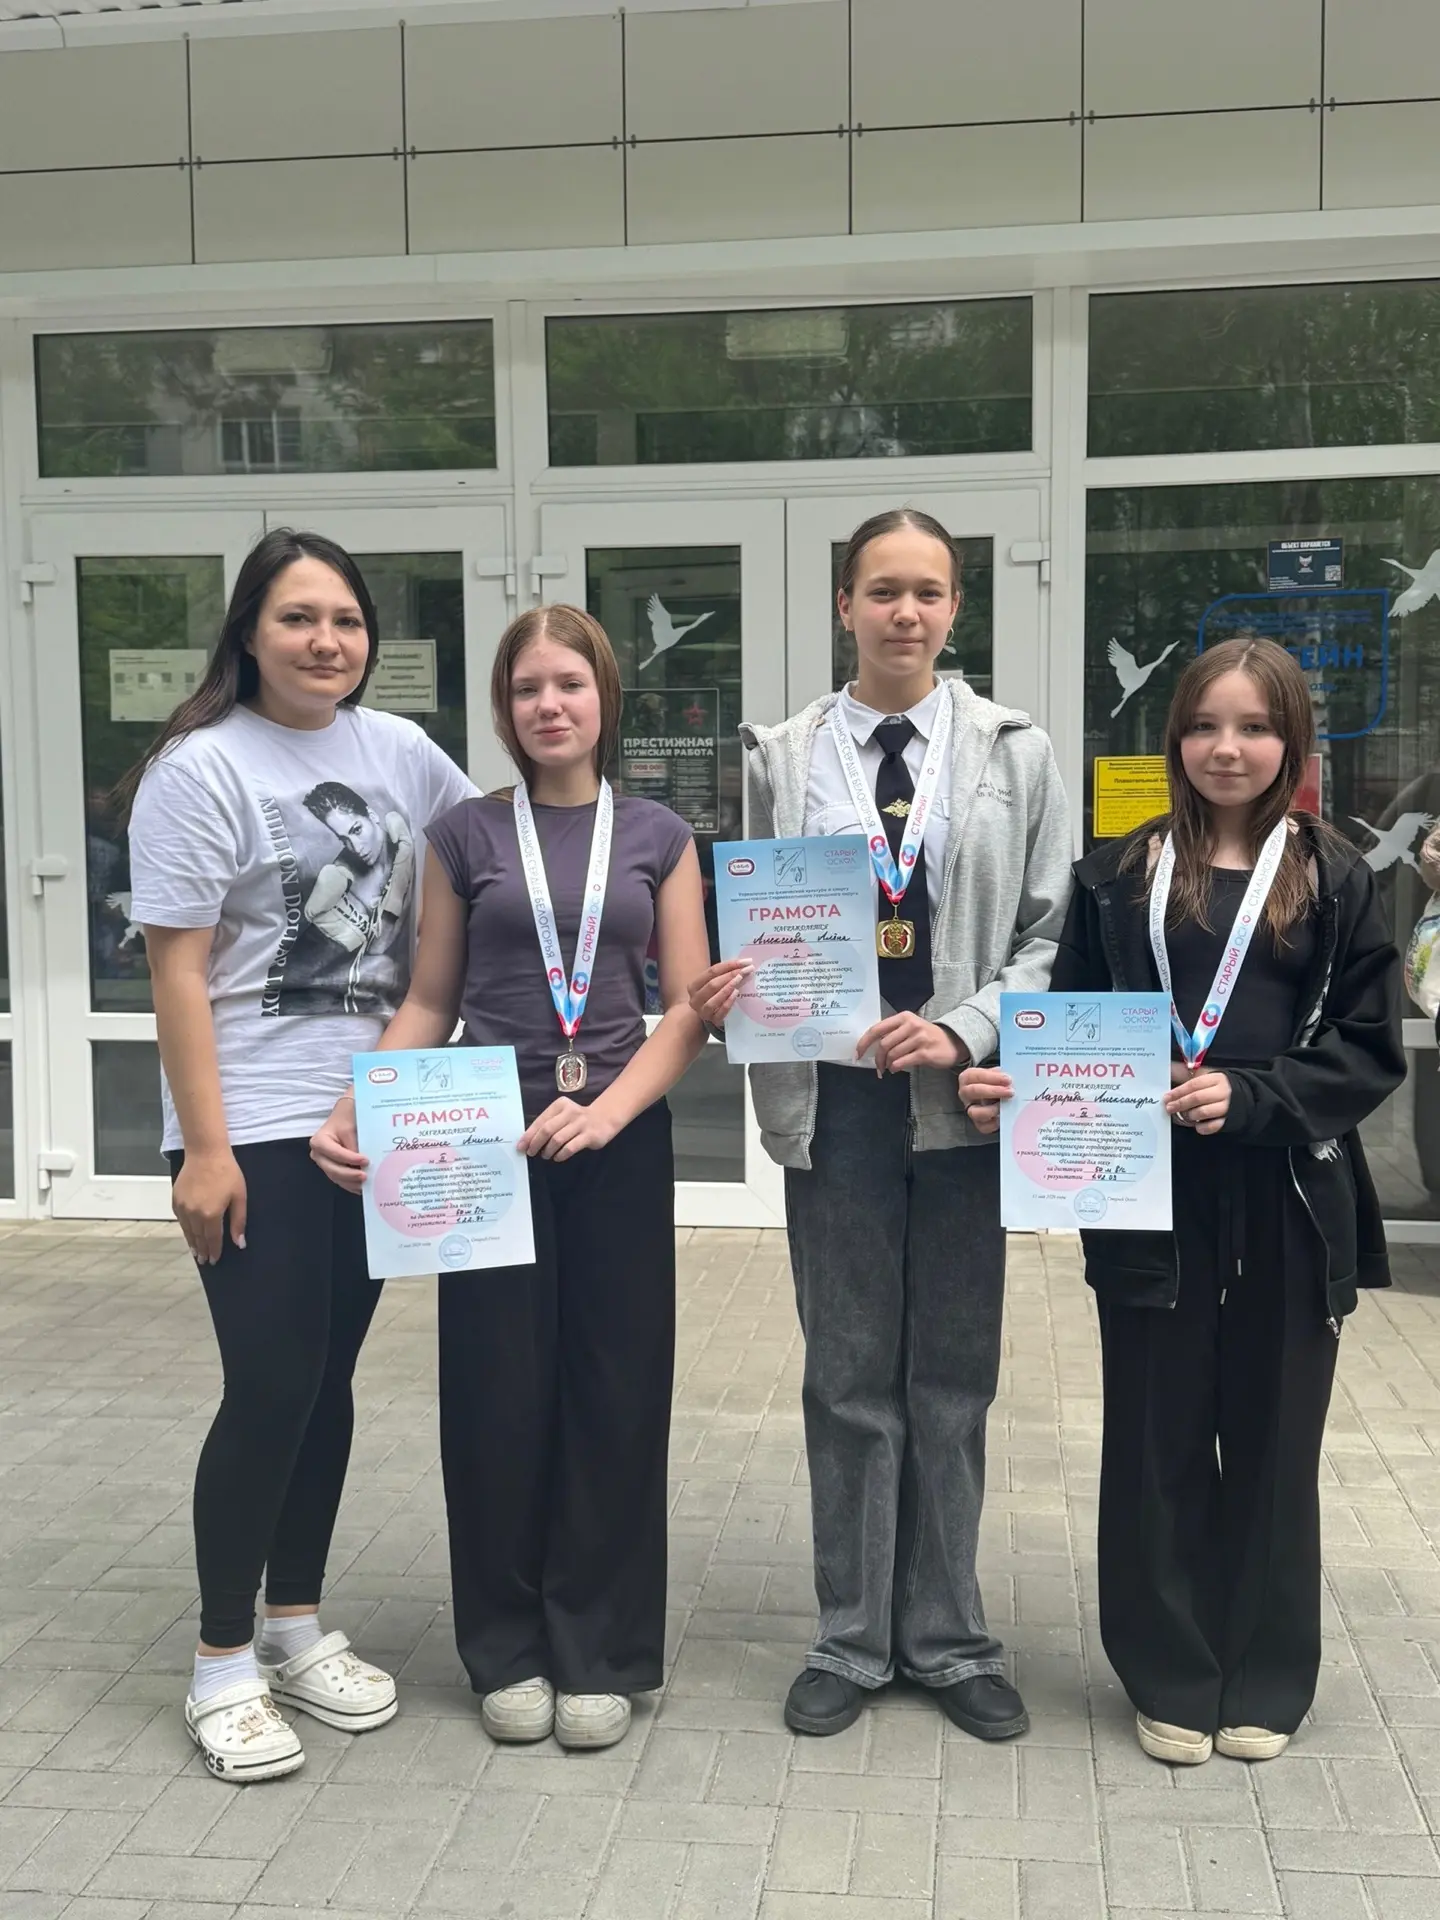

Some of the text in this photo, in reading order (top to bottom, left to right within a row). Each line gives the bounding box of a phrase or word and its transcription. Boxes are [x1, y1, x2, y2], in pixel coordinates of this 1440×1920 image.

[623, 737, 714, 748] ПРЕСТИЖНАЯ
[624, 748, 714, 757] МУЖСКАЯ РАБОТА
[851, 775, 876, 828] БЕЛОГОРЬЯ
[911, 795, 928, 836] СТАРЫЙ
[824, 849, 858, 858] СТАРЫЙ
[827, 857, 857, 866] ОСКОЛ
[518, 813, 534, 860] СТАЛЬНОЕ
[534, 895, 556, 959] БЕЛОГОРЬЯ
[259, 796, 302, 1016] MILLION DOLLAR LDY
[749, 903, 841, 922] ГРАМОТА
[773, 924, 830, 932] НАГРАЖДАЕТСЯ
[581, 916, 597, 963] СТАРЫЙ
[1217, 948, 1240, 995] СТАРЫЙ
[1121, 1007, 1159, 1015] СТАРЫЙ
[1124, 1016, 1156, 1024] ОСКОЛ
[1035, 1063, 1135, 1078] ГРАМОТА
[1061, 1083, 1121, 1091] НАГРАЖДАЕТСЯ
[1094, 1091, 1160, 1108] Александра
[392, 1107, 489, 1127] ГРАМОТА
